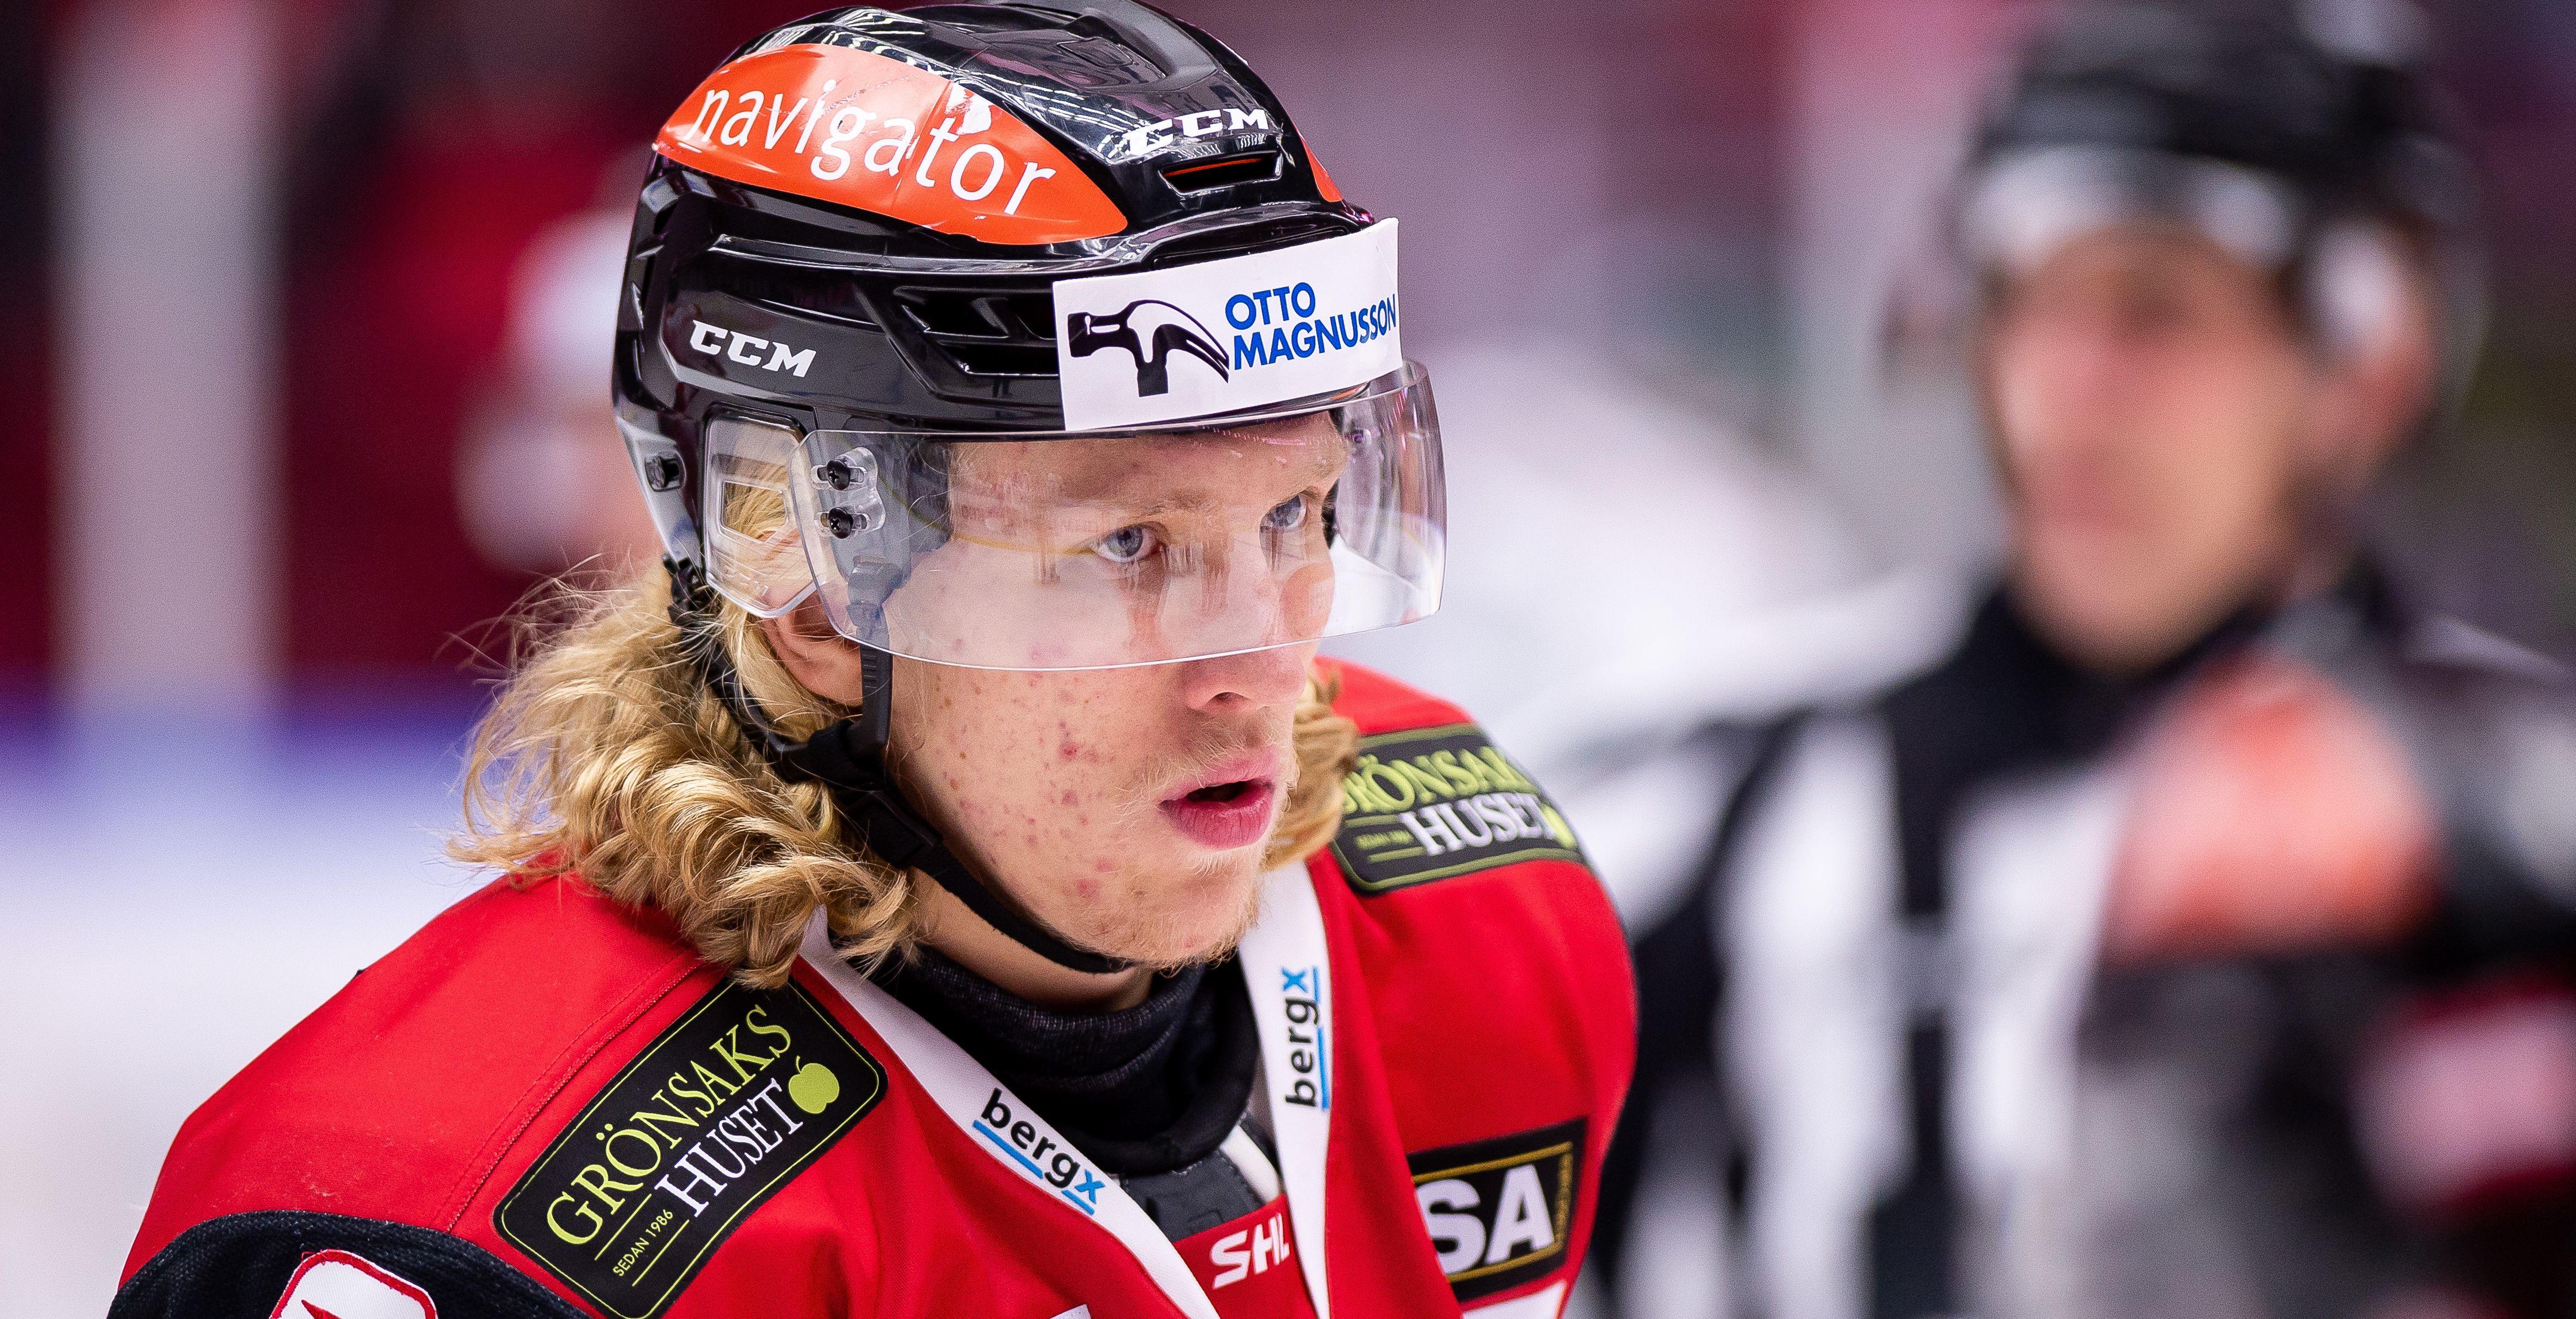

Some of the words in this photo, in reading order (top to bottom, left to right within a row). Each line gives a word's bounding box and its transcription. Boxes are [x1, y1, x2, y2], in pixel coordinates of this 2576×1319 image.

[685, 79, 1056, 215] navigator
[1128, 108, 1269, 156] CCM
[1225, 282, 1316, 330] OTTO
[1234, 293, 1397, 371] MAGNUSSON
[690, 320, 817, 378] CCM
[1398, 792, 1556, 856] HUSET
[1282, 967, 1320, 1108] bergx
[546, 1004, 791, 1245] GRÖNSAKS
[654, 1078, 804, 1218] HUSET
[980, 1088, 1107, 1204] bergx
[612, 1237, 650, 1276] SEDAN
[645, 1209, 674, 1238] 1986
[1210, 1212, 1290, 1289] SHL
